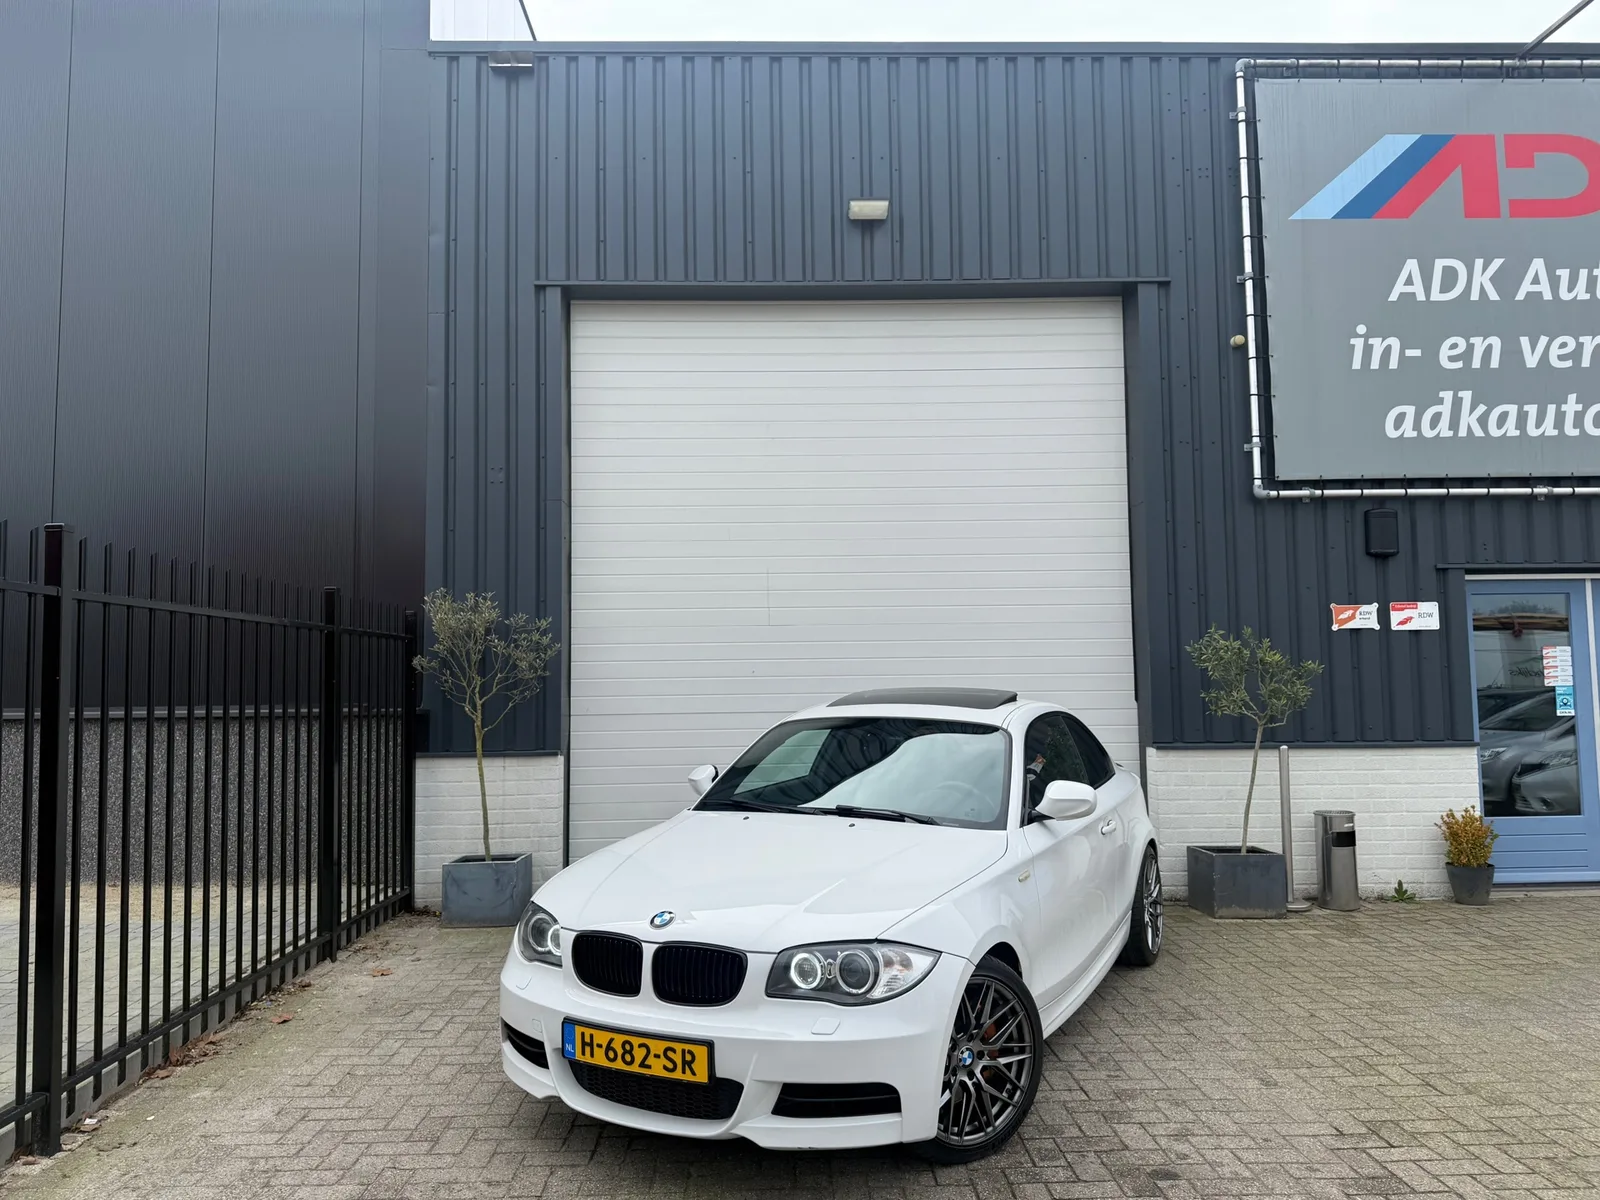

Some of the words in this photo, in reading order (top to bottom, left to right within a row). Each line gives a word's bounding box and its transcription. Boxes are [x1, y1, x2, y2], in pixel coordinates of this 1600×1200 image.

[1388, 258, 1505, 301] ADK
[1349, 324, 1422, 370] in-
[1439, 334, 1502, 369] en
[1519, 334, 1600, 369] ver
[1417, 611, 1434, 619] RDW
[565, 1043, 574, 1053] NL
[580, 1031, 697, 1077] H-682-SR
